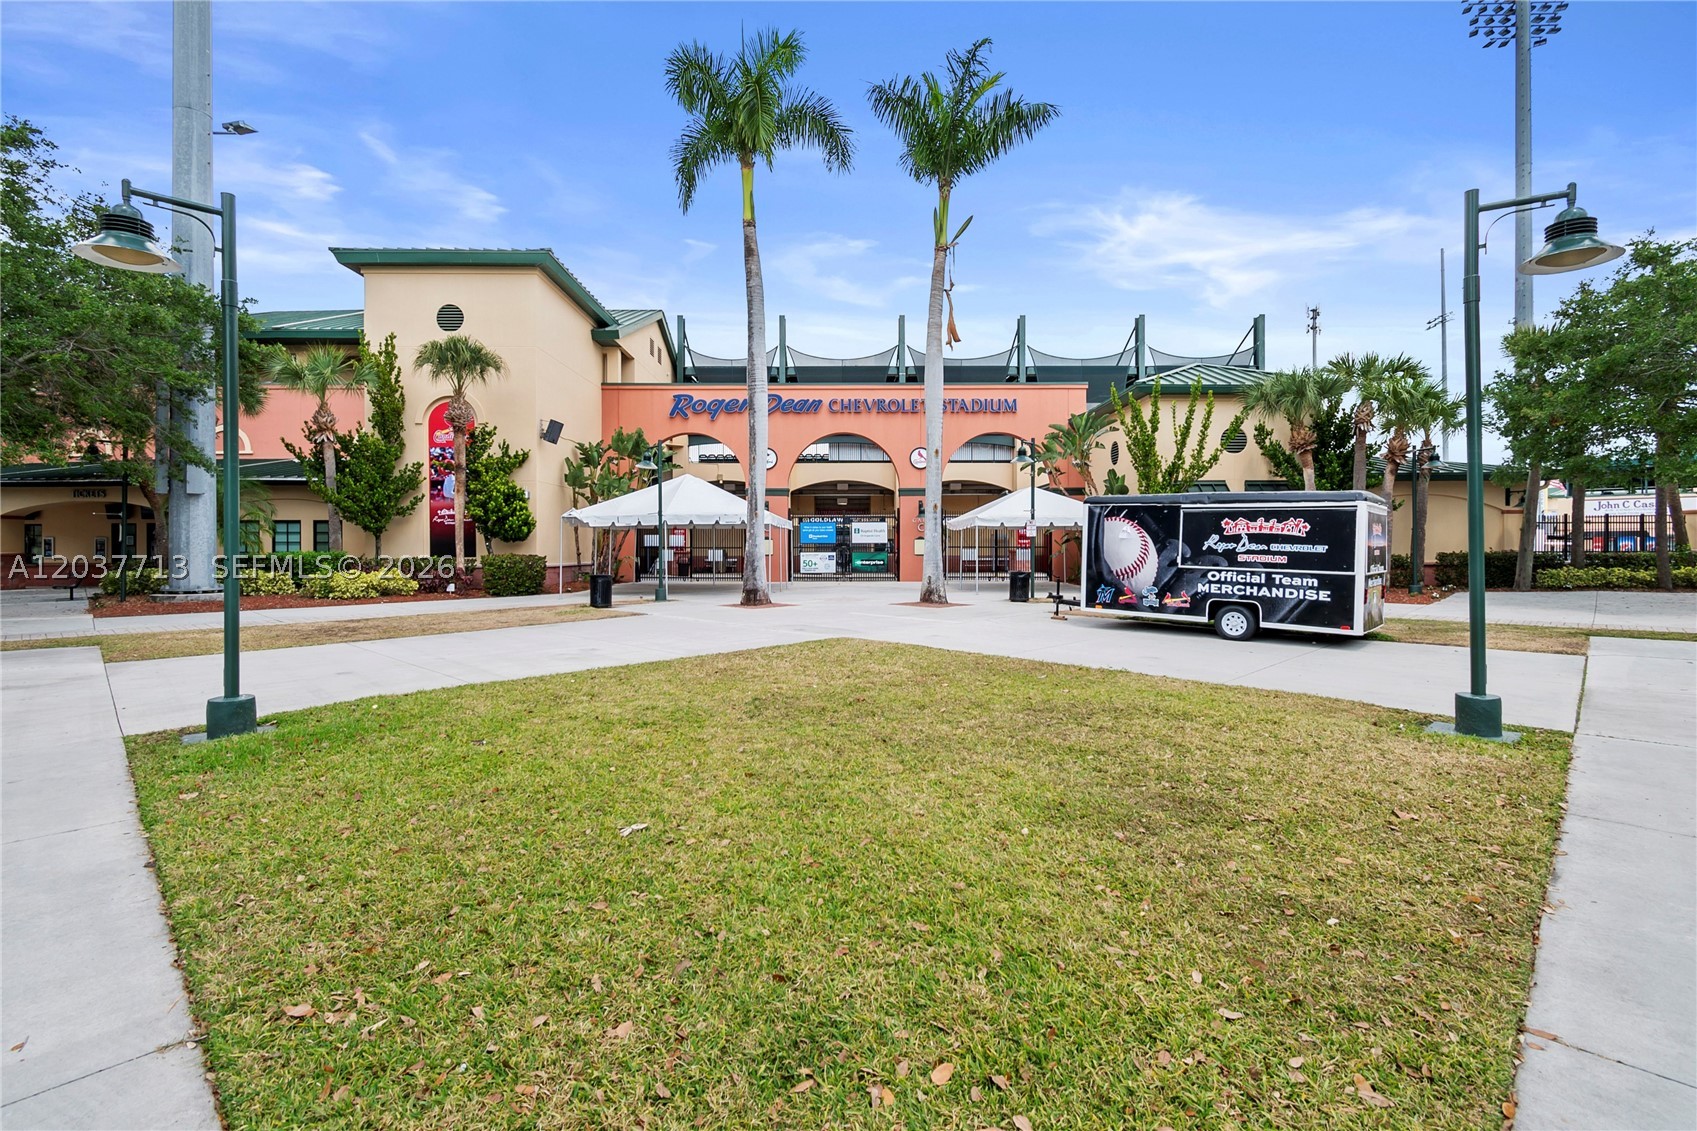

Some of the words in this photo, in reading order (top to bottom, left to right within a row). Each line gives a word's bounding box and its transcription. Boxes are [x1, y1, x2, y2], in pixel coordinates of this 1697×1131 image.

[670, 393, 748, 420] Roger
[768, 393, 823, 412] Dean
[1593, 501, 1620, 511] John
[1622, 500, 1630, 508] C
[1269, 543, 1329, 553] CHEVROLET
[802, 559, 817, 568] 50+
[1238, 554, 1288, 564] STADIUM
[1207, 570, 1266, 583] Official
[1271, 573, 1318, 587] Team
[1197, 582, 1332, 601] MERCHANDISE
